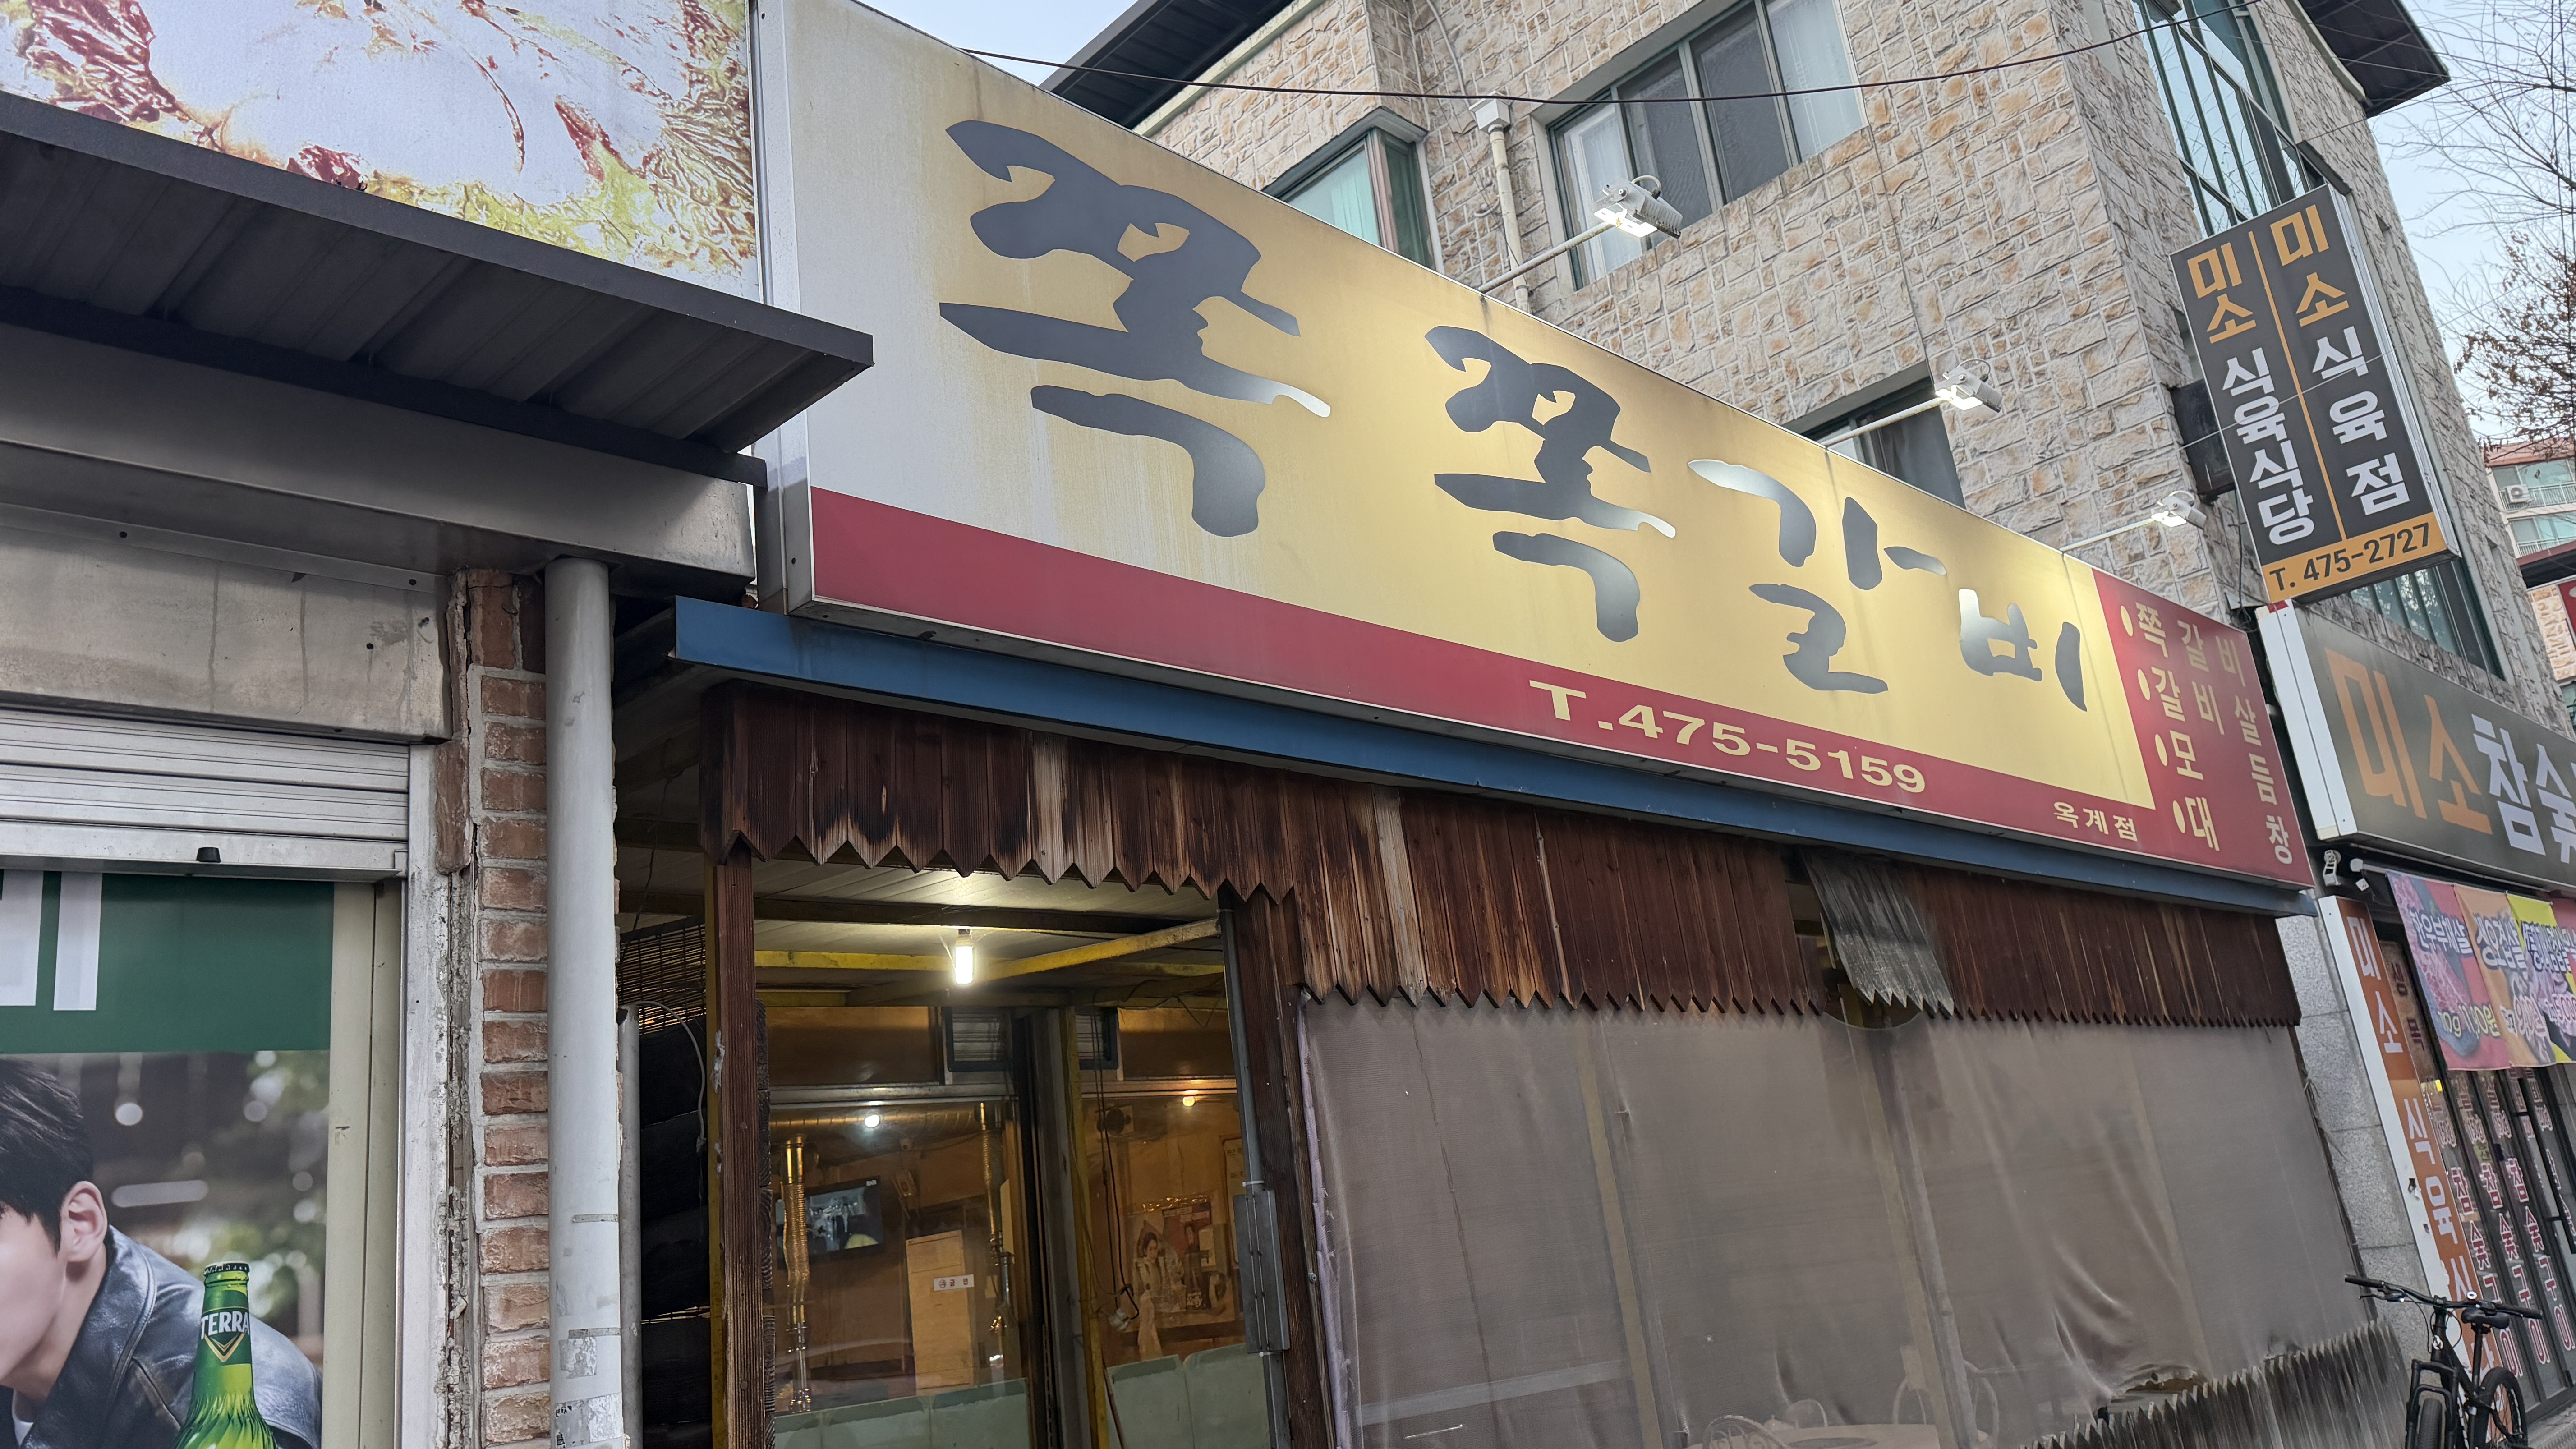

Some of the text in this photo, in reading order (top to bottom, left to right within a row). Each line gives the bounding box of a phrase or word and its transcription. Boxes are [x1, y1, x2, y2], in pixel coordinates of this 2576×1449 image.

[2187, 242, 2314, 545] 미소 식육식당
[2270, 204, 2410, 516] 미소 식육점
[2304, 522, 2429, 581] 475-2727
[2135, 602, 2246, 687] 쪽갈비
[2151, 666, 2262, 746] 갈비살
[2053, 802, 2138, 842] 옥계점
[2472, 714, 2576, 863] 참숯
[2409, 908, 2473, 955] 한우부채살
[2347, 916, 2403, 1053] 미소
[201, 1311, 250, 1339] TERRA
